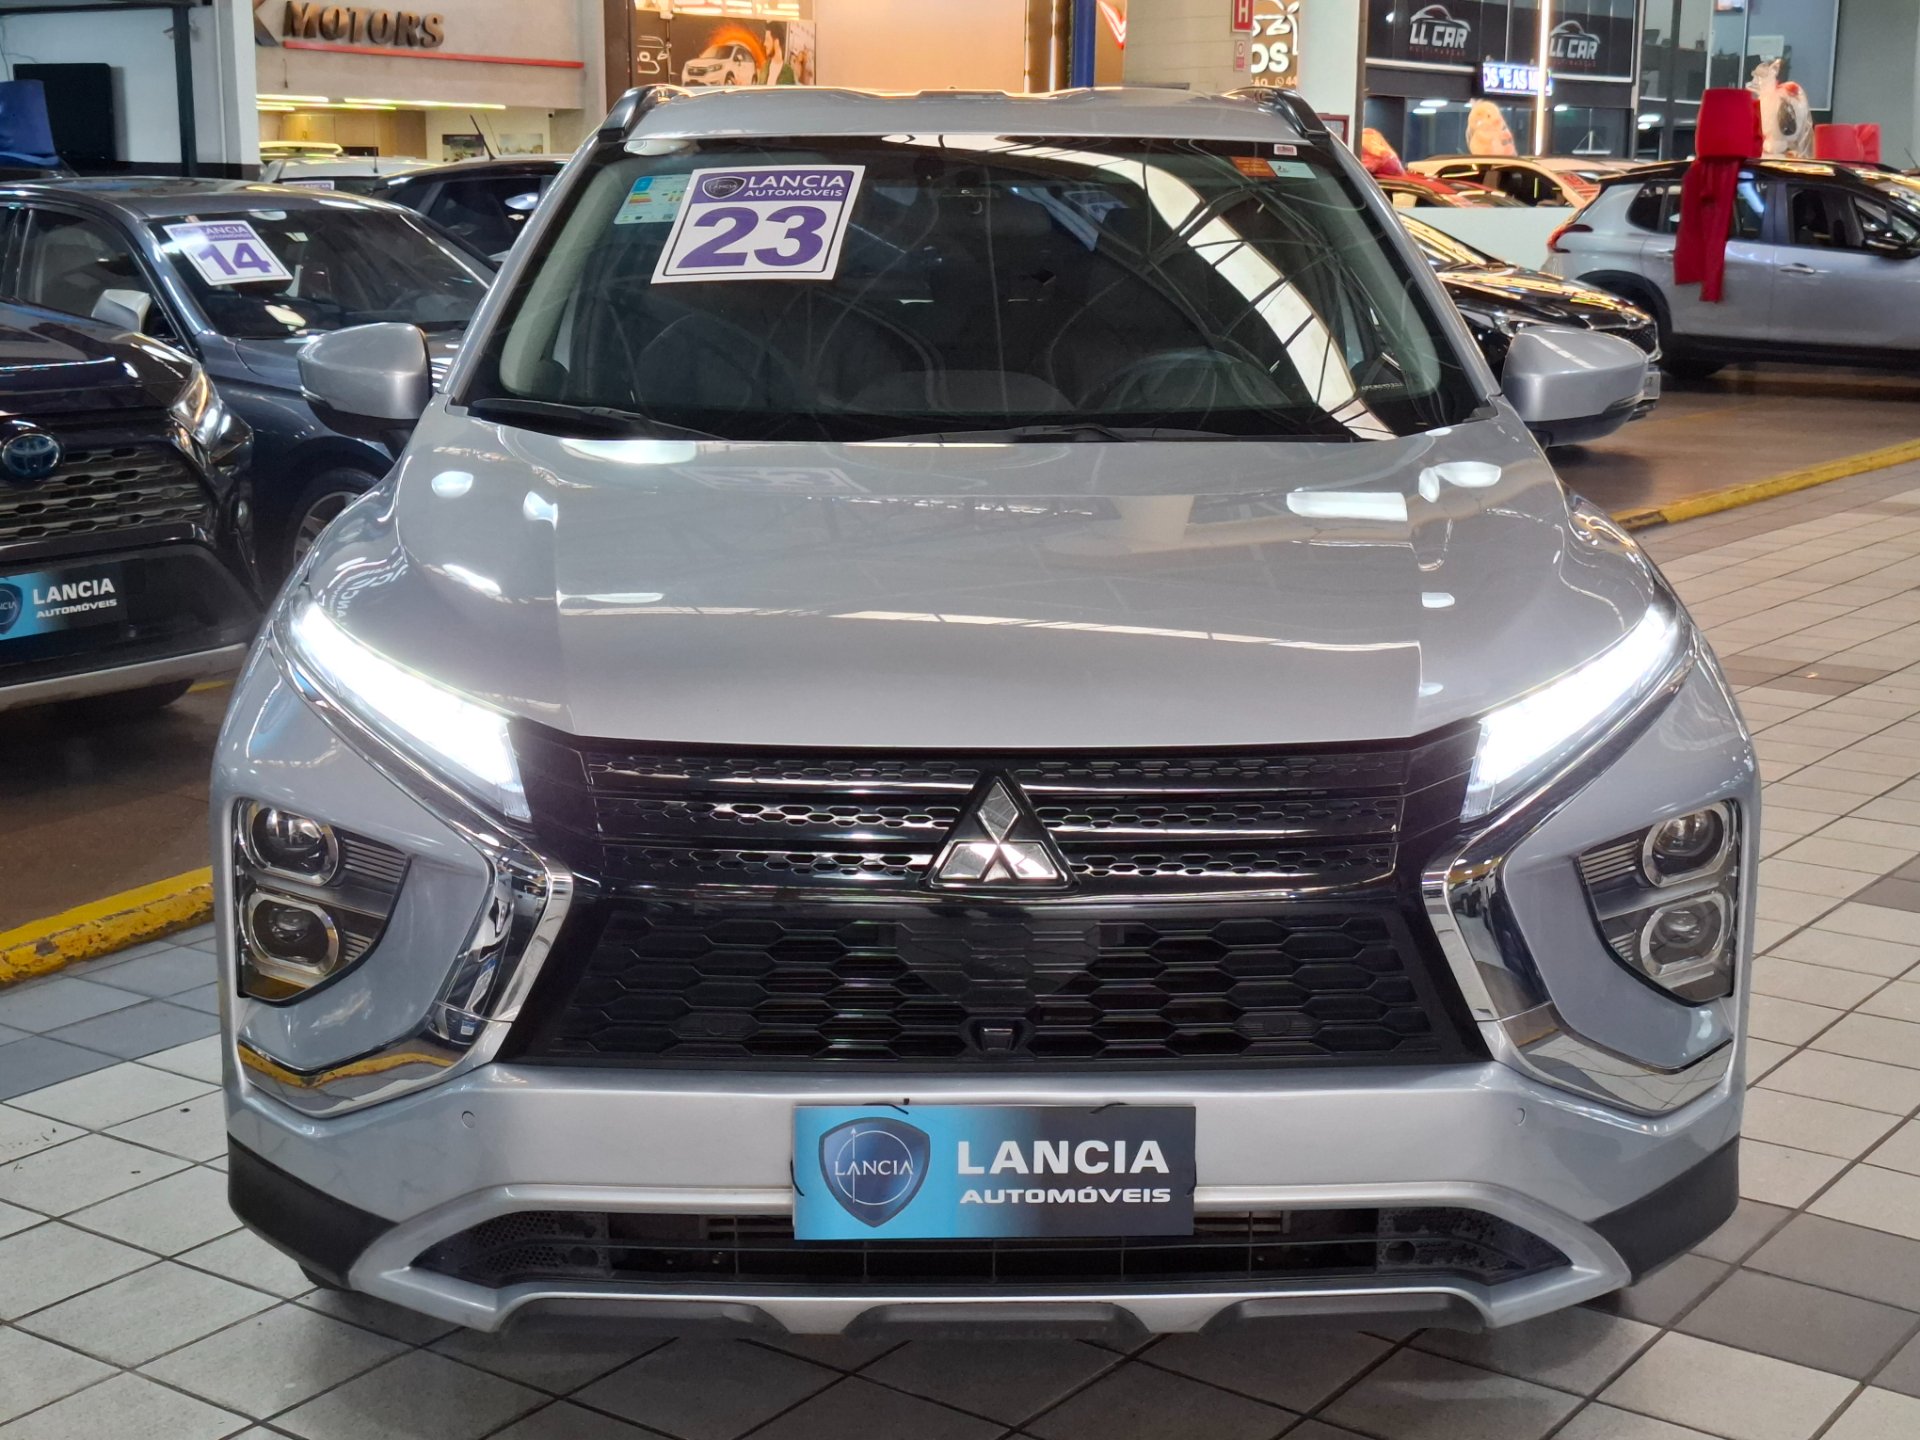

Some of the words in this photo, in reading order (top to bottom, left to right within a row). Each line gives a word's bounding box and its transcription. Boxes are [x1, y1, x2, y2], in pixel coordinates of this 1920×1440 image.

[283, 1, 445, 48] MOTORS
[1409, 23, 1428, 45] LL
[1432, 25, 1468, 48] CAR
[1549, 38, 1564, 58] LL
[1567, 39, 1598, 60] CAR
[744, 187, 843, 197] AUTOMÓVEIS
[748, 175, 845, 188] LANCIA
[206, 225, 249, 235] ANCIA
[677, 205, 827, 269] 23
[198, 242, 272, 275] 14
[33, 578, 116, 605] LANCIA
[36, 598, 118, 618] AUTOMÓVEIS
[834, 1160, 914, 1176] LANCIA
[957, 1140, 1170, 1174] LANCIA
[959, 1185, 1171, 1204] AUTOMÓVEIS
